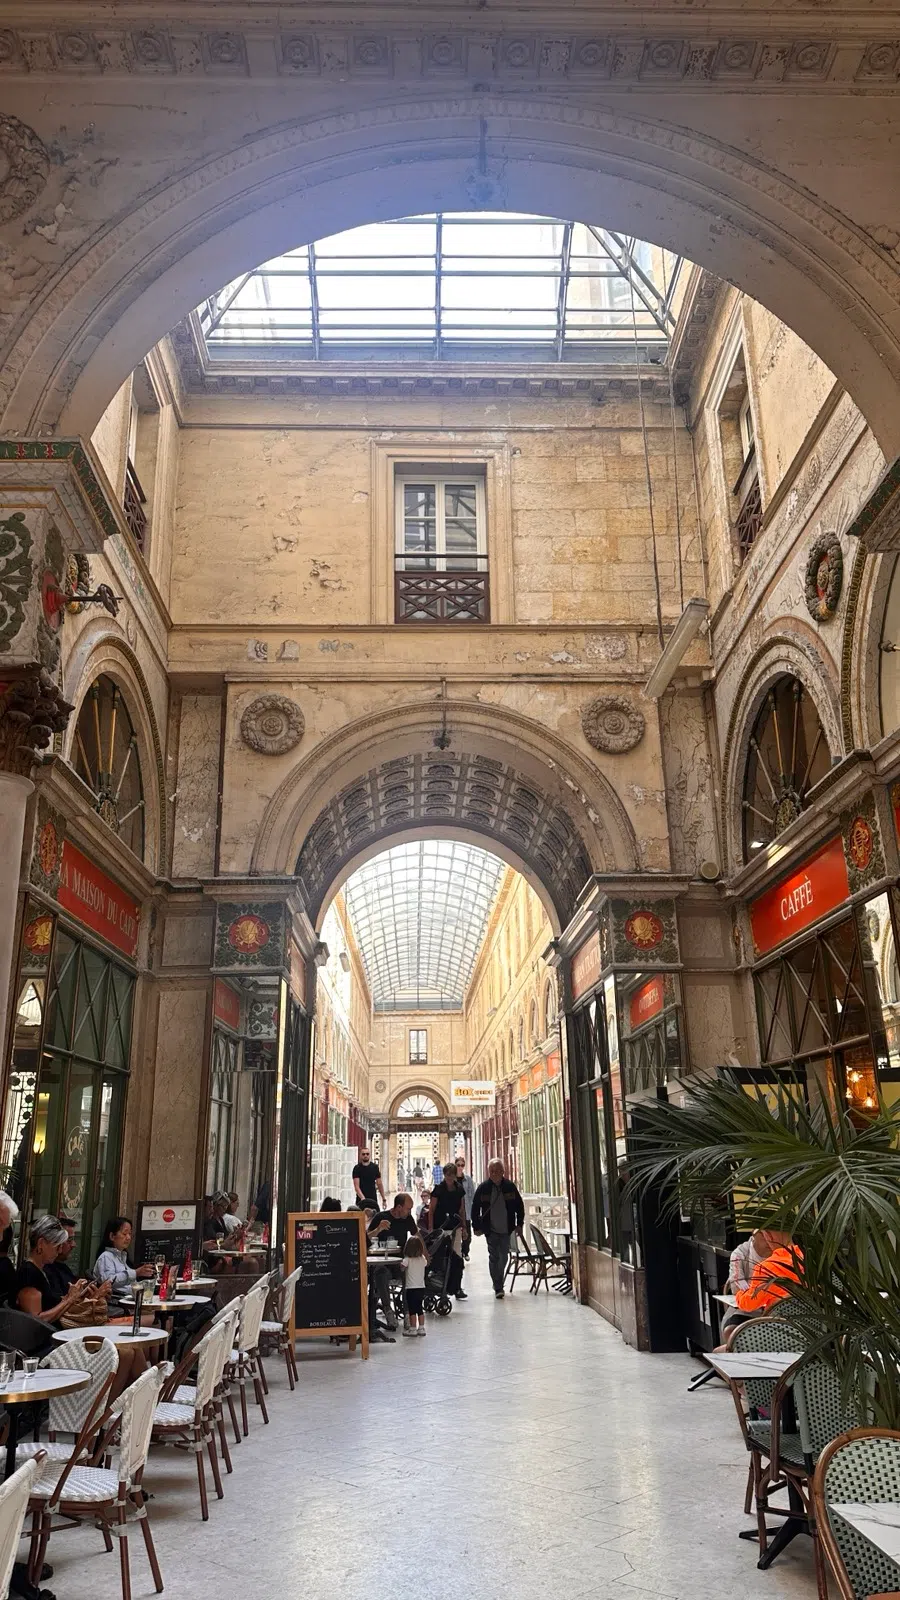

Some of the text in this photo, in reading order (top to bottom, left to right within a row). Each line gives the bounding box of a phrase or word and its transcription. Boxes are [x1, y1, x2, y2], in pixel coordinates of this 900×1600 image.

[72, 867, 105, 914] MAISON
[107, 896, 119, 925] DU
[780, 876, 814, 921] CAFFÈ
[298, 1231, 311, 1239] Vin
